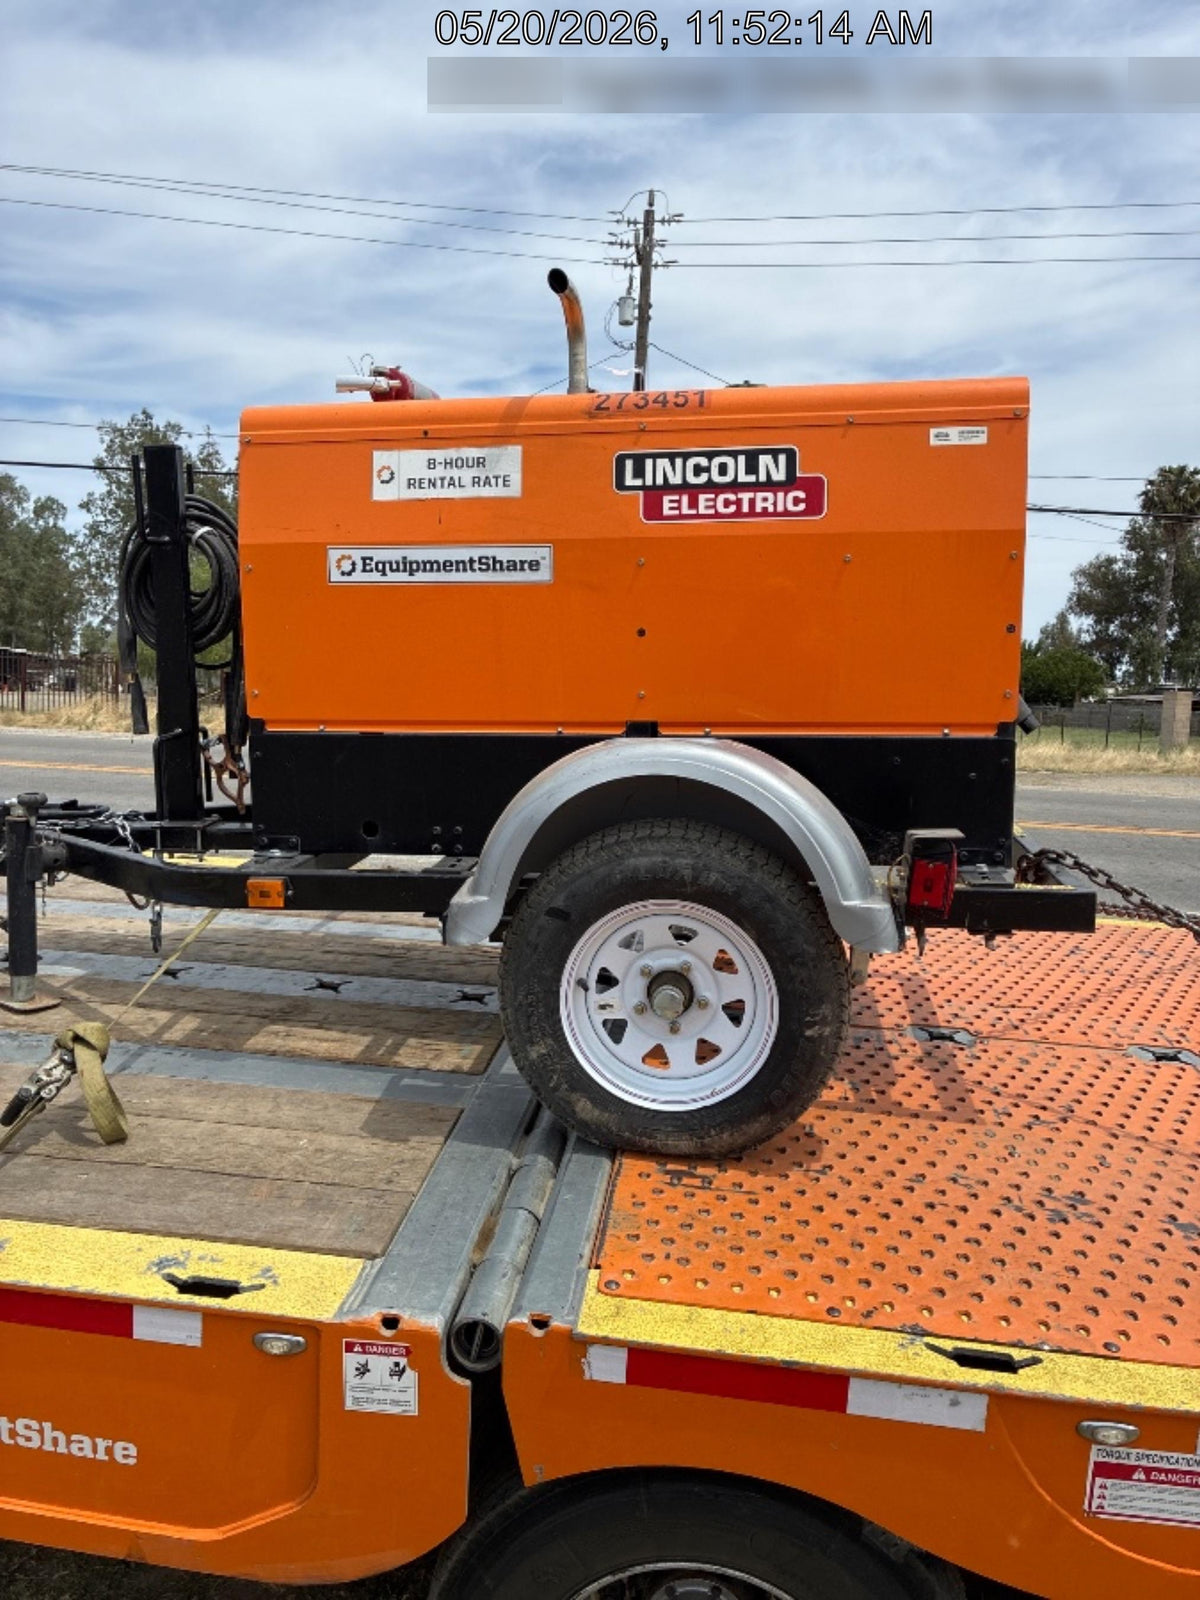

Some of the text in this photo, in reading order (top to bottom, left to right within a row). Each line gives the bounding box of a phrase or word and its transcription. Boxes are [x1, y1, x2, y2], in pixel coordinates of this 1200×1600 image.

[594, 389, 706, 412] 273451
[427, 456, 487, 471] 8-HOUR
[624, 453, 787, 486] LINCOLN
[406, 474, 512, 490] RENTAL RATE
[662, 490, 807, 516] ELECTRIC
[360, 555, 542, 577] EquipmentShare
[365, 1345, 407, 1356] DANGER
[1096, 1448, 1133, 1460] TORQUE
[1150, 1471, 1200, 1485] DANGER
